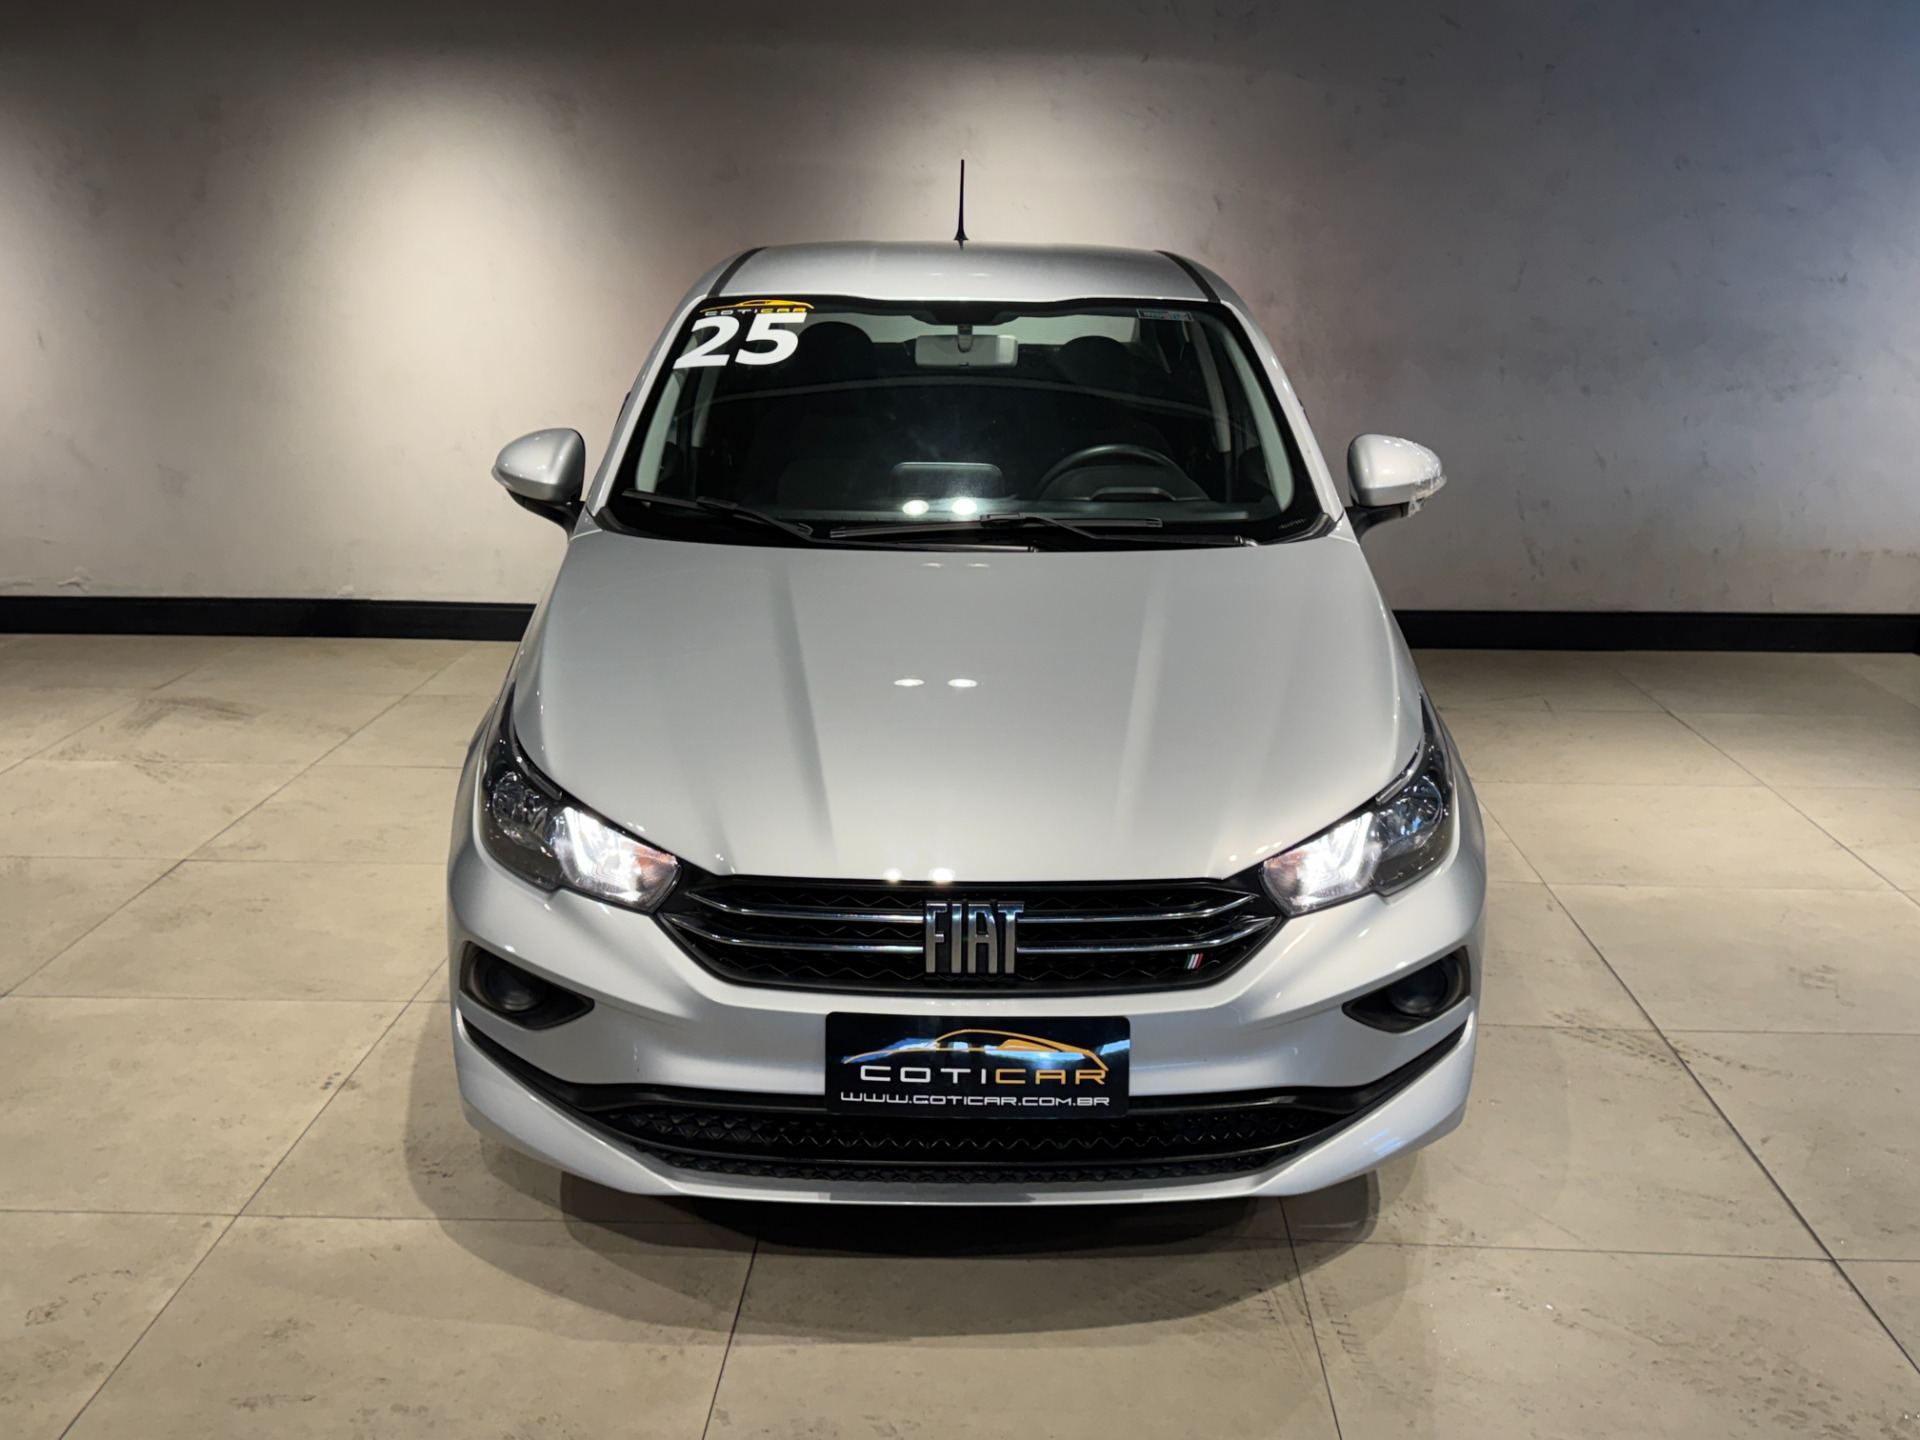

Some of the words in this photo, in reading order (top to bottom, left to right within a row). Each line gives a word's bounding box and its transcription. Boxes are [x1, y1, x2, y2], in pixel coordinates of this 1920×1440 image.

[673, 313, 807, 369] 25
[926, 902, 1025, 973] FIAT
[860, 1065, 1106, 1085] COTICAR
[840, 1092, 1110, 1107] WWW.COTICAR.COM.BR
